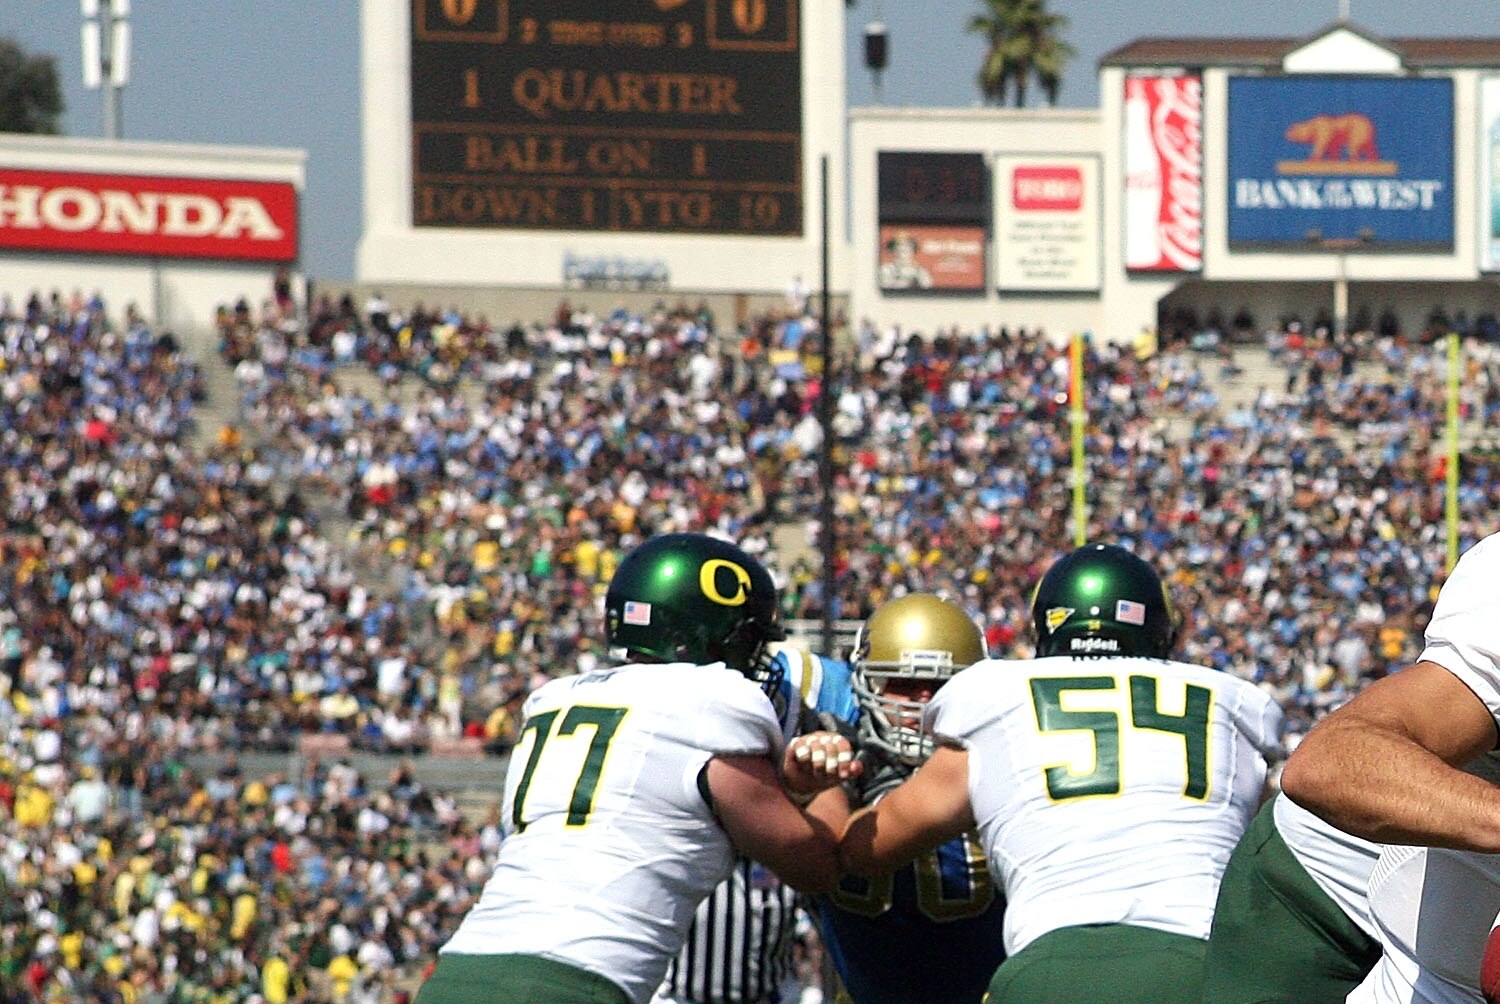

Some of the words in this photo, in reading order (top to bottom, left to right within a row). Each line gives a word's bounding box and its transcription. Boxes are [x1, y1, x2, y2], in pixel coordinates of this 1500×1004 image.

[464, 69, 480, 108] 1
[512, 68, 743, 118] QUARTER
[465, 136, 578, 172] BALL
[587, 140, 653, 174] ON
[693, 143, 707, 176] 1
[0, 185, 284, 241] HONDA
[419, 187, 562, 223] DOWN
[1235, 178, 1324, 209] BANK
[1351, 178, 1442, 210] WEST
[1028, 674, 1213, 805] 54
[512, 703, 632, 834] 77
